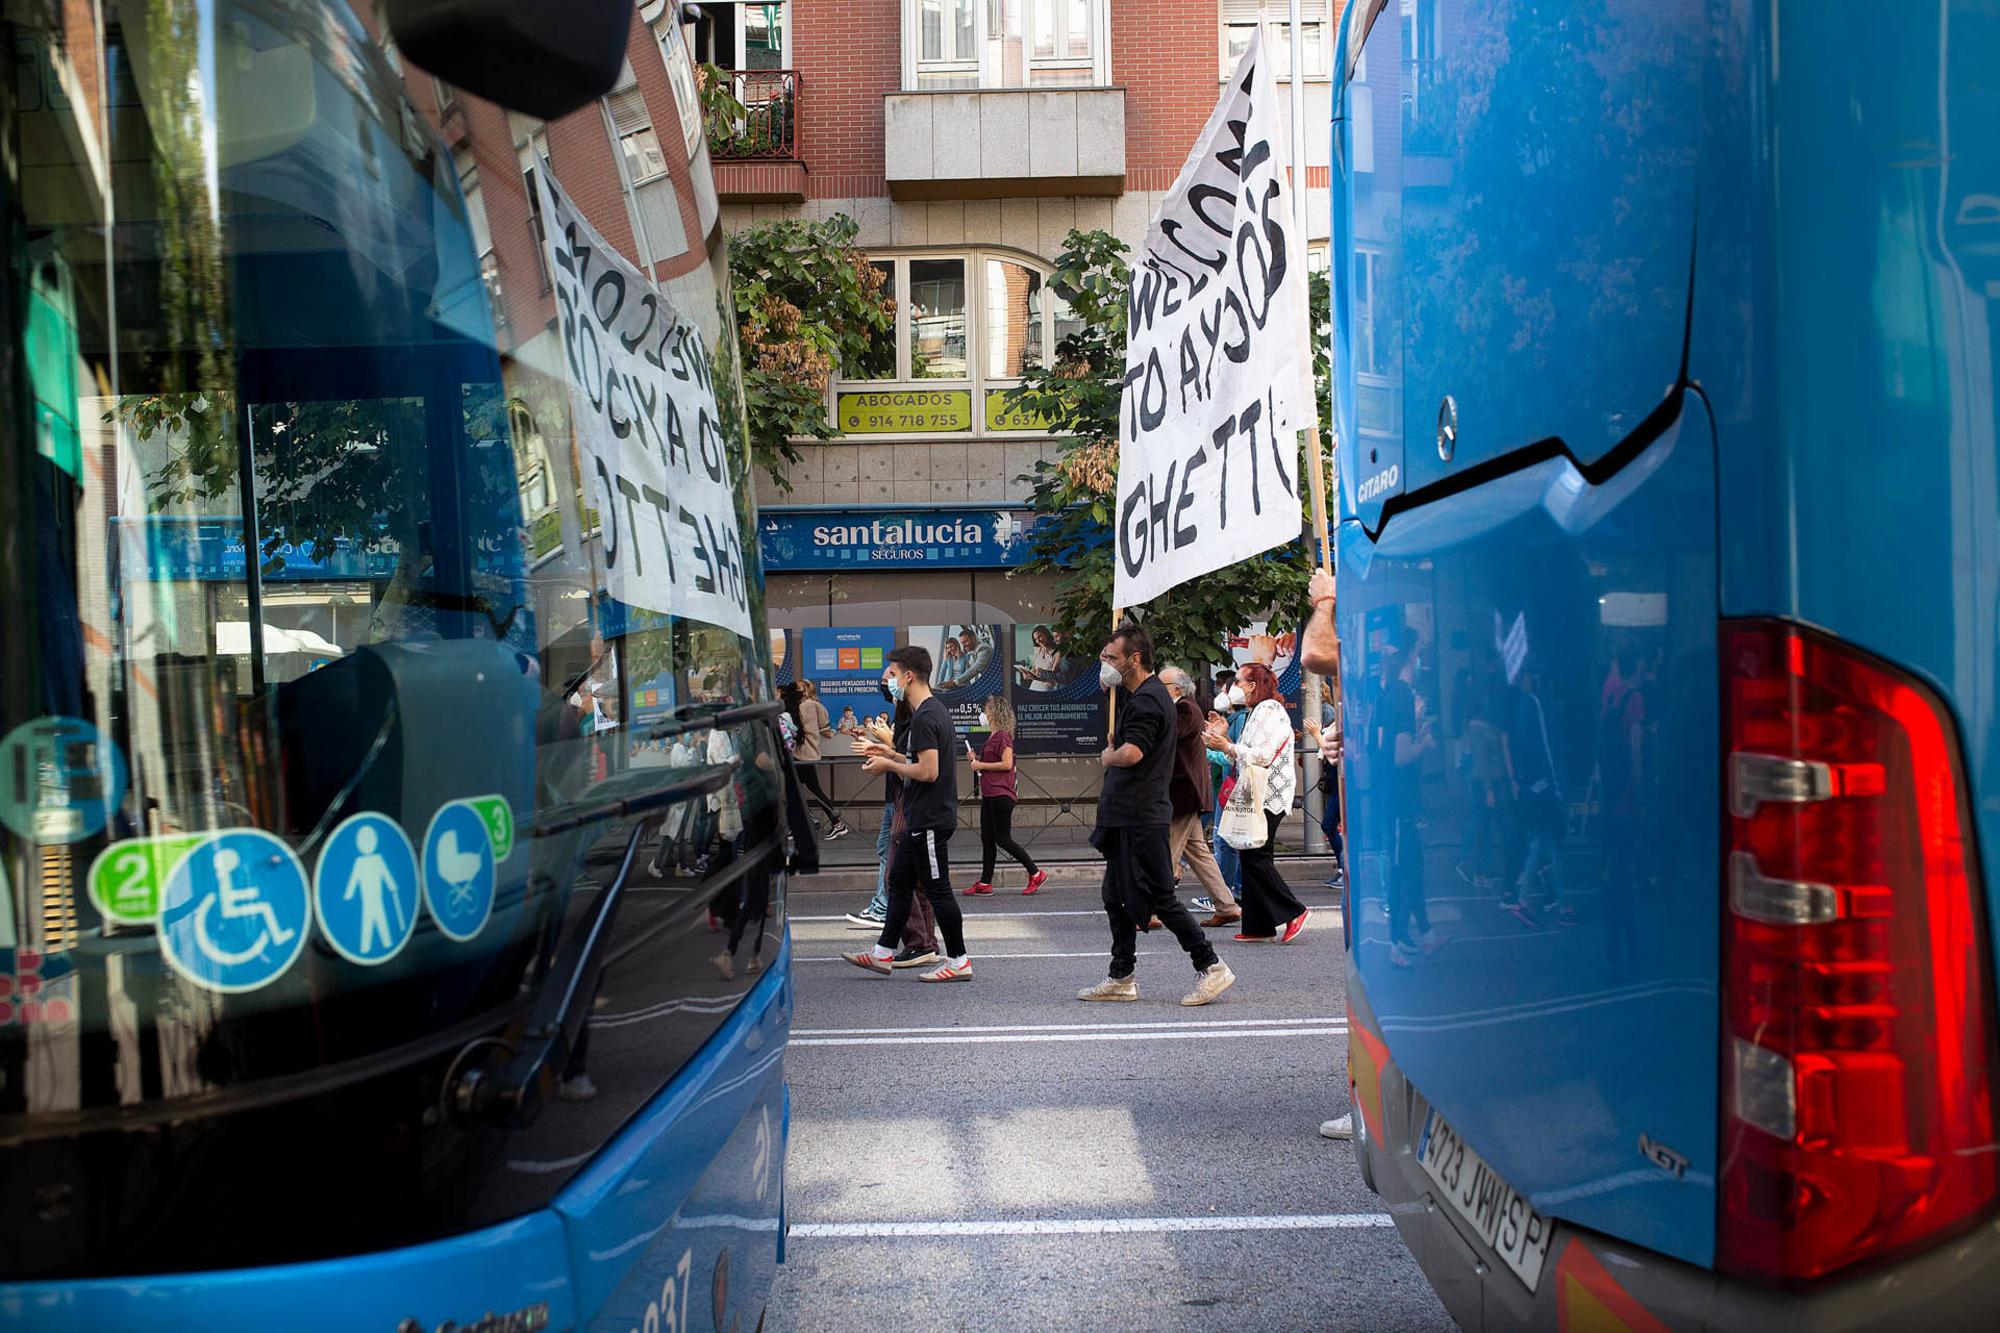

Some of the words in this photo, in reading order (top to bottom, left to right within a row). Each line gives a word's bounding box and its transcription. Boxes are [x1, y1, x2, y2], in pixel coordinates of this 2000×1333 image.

[1129, 64, 1270, 341] WELCOM
[856, 394, 953, 407] ABOGADOS
[1123, 347, 1167, 442] TO
[869, 415, 893, 427] 914
[900, 415, 925, 426] 718
[930, 414, 958, 426] 755
[1358, 464, 1399, 503] CITARO
[813, 518, 982, 546] santalucía
[871, 548, 924, 560] SEGUROS
[492, 805, 506, 842] 3
[115, 853, 151, 898] 2
[1428, 1114, 1465, 1192] 4723
[1638, 1134, 1691, 1177] NGT
